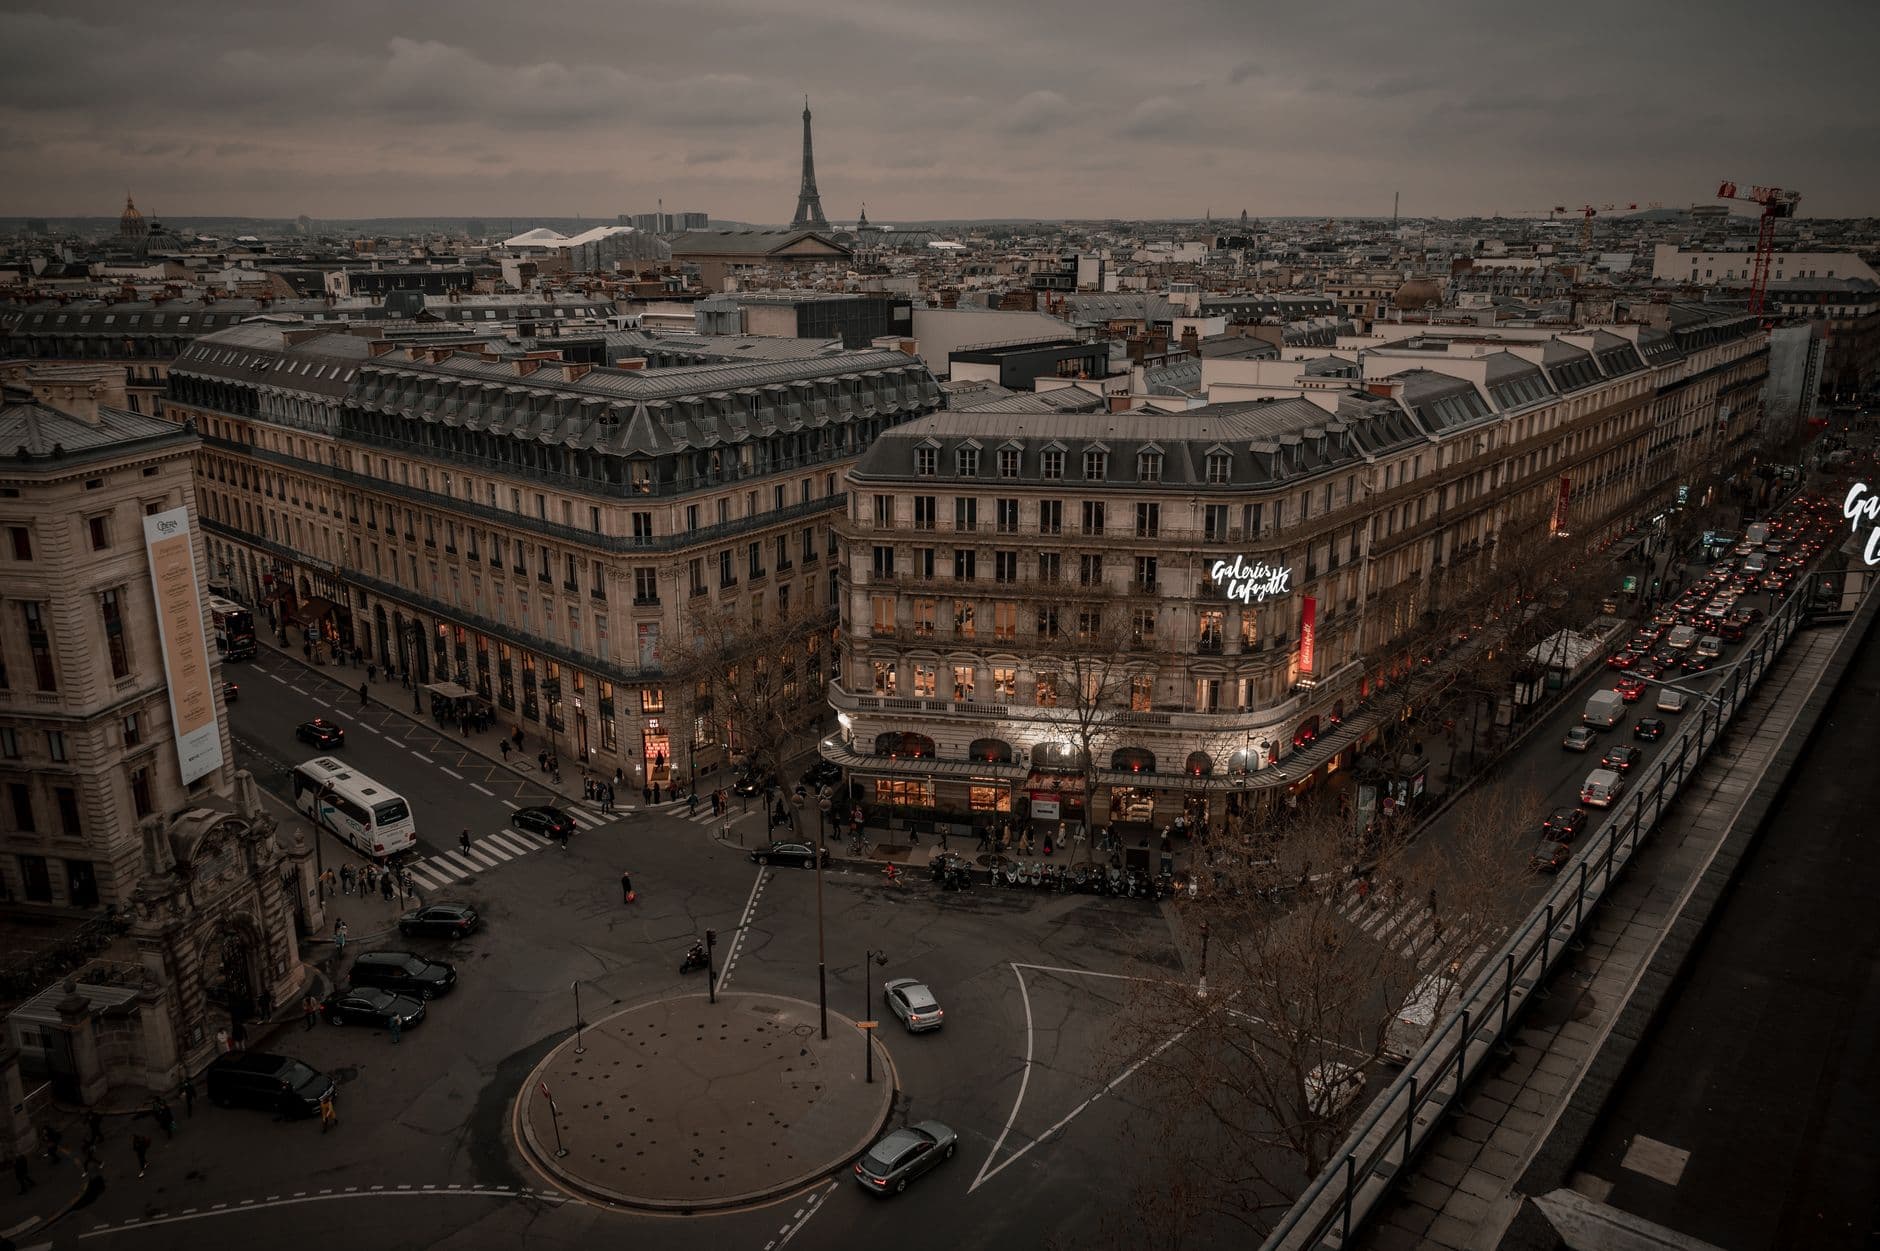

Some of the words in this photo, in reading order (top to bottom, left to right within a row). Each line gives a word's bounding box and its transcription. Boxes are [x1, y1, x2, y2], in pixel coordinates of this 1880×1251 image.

[1864, 526, 1880, 566] L
[1211, 554, 1271, 585] Galeries
[1227, 567, 1292, 604] Lafayette
